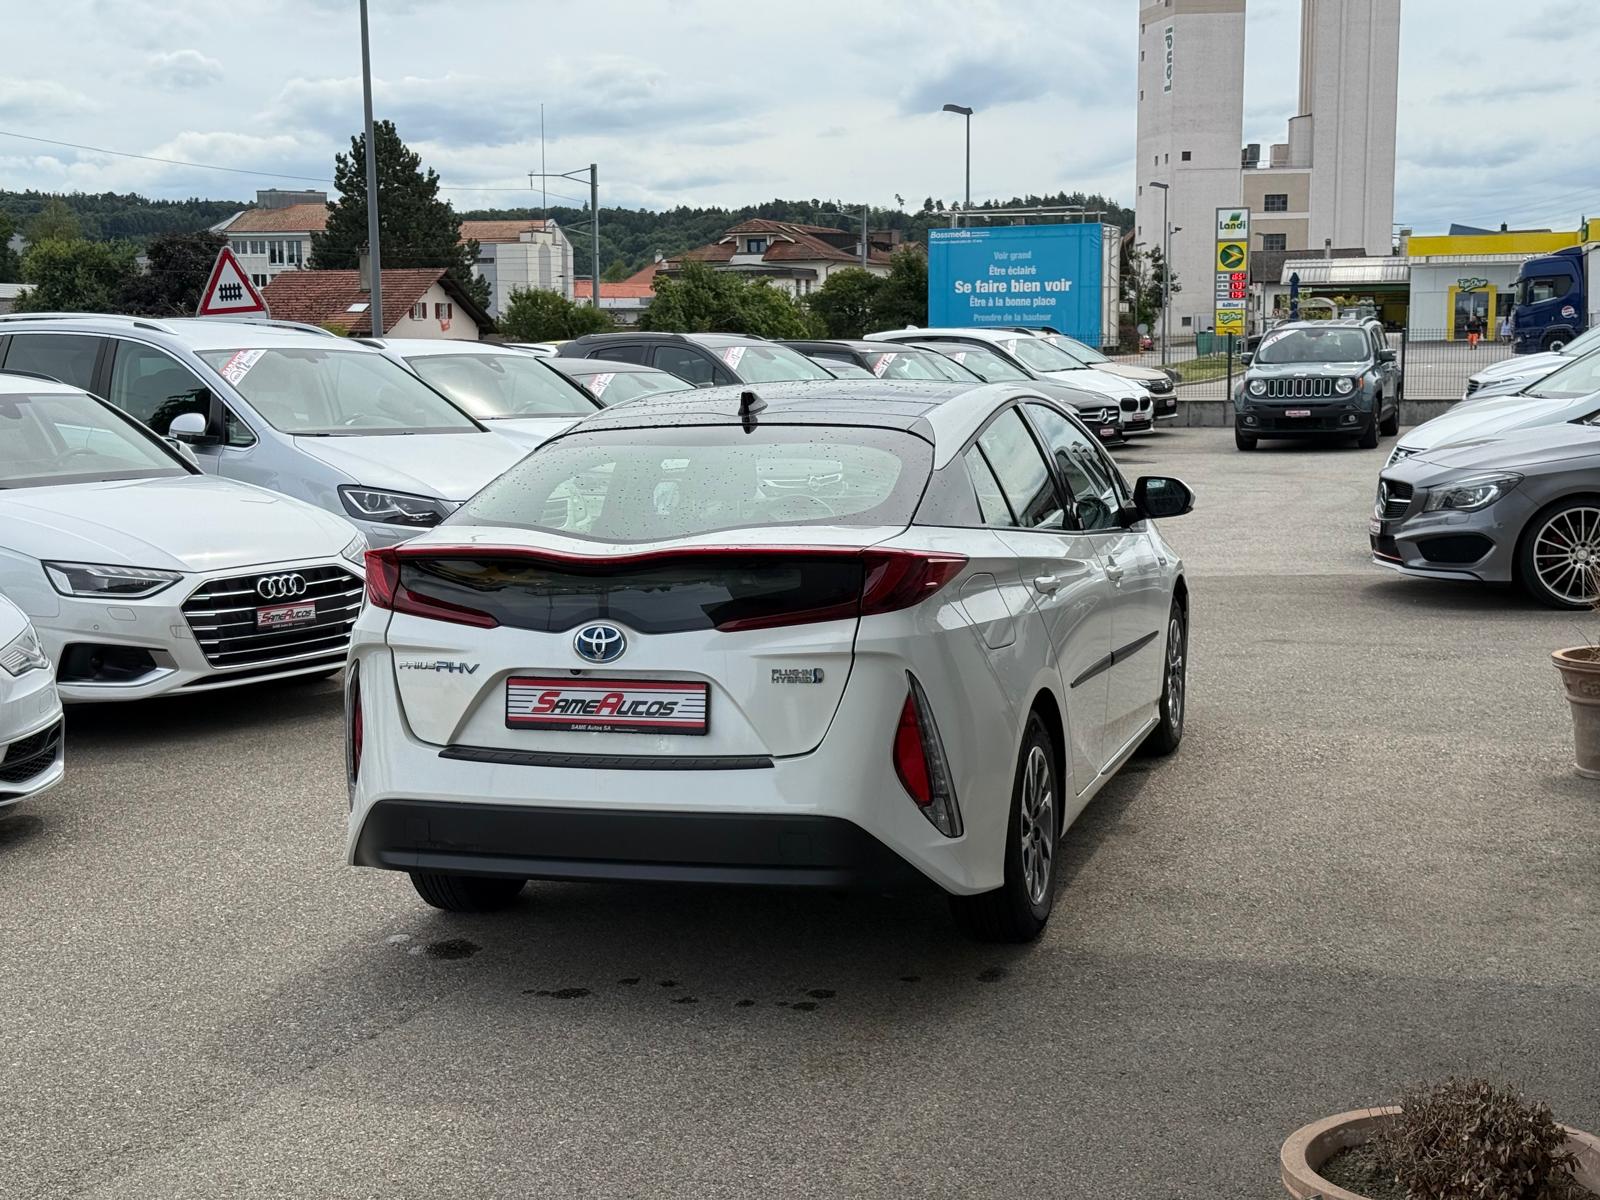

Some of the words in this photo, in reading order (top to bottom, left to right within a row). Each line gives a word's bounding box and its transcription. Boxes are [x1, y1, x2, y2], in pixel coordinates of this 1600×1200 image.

[1164, 26, 1173, 92] Landi
[1219, 220, 1246, 230] Landi
[930, 230, 970, 239] Bossmedia
[993, 251, 1008, 260] Voir
[1010, 250, 1032, 261] grand
[989, 264, 1006, 275] Être
[1007, 265, 1036, 275] éclairé
[955, 280, 972, 293] Se
[975, 279, 1007, 293] faire
[1011, 279, 1041, 292] bien
[1044, 278, 1073, 292] voir
[969, 295, 986, 307] Être
[987, 296, 994, 306] à
[995, 296, 1004, 306] la
[1005, 297, 1032, 306] bonne
[1033, 296, 1057, 308] place
[973, 313, 1002, 321] Prendre
[1003, 313, 1012, 321] de
[1014, 313, 1021, 321] la
[1023, 313, 1051, 321] hauteur
[399, 660, 436, 670] PRIUS
[436, 660, 480, 674] PHV
[771, 668, 813, 677] PLUG-IN
[771, 676, 813, 684] HYBRID
